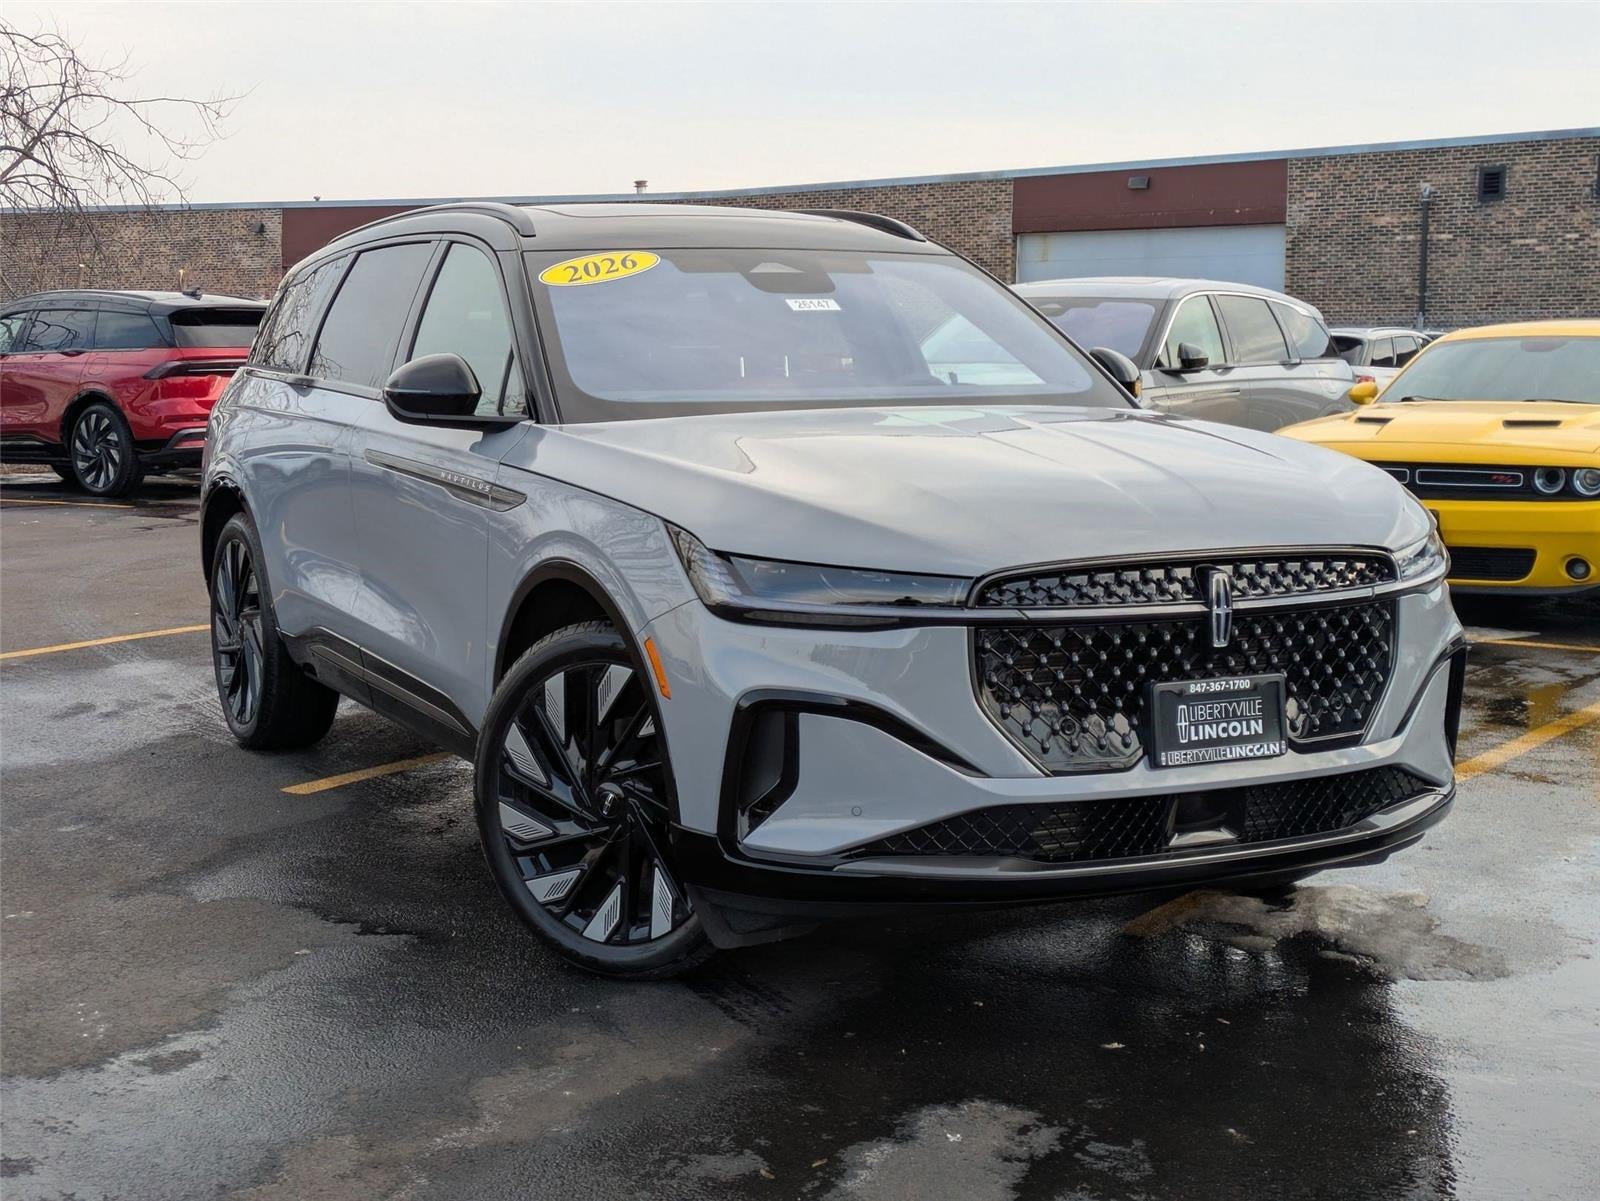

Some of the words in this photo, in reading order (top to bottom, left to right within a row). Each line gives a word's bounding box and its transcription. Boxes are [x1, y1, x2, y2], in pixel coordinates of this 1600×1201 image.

[563, 254, 638, 283] 2026
[440, 471, 490, 492] NAUTILUS
[1189, 679, 1251, 693] 847-367-1700
[1189, 700, 1263, 721] LIBERTYVILLE
[1190, 719, 1263, 741] LINCOLN
